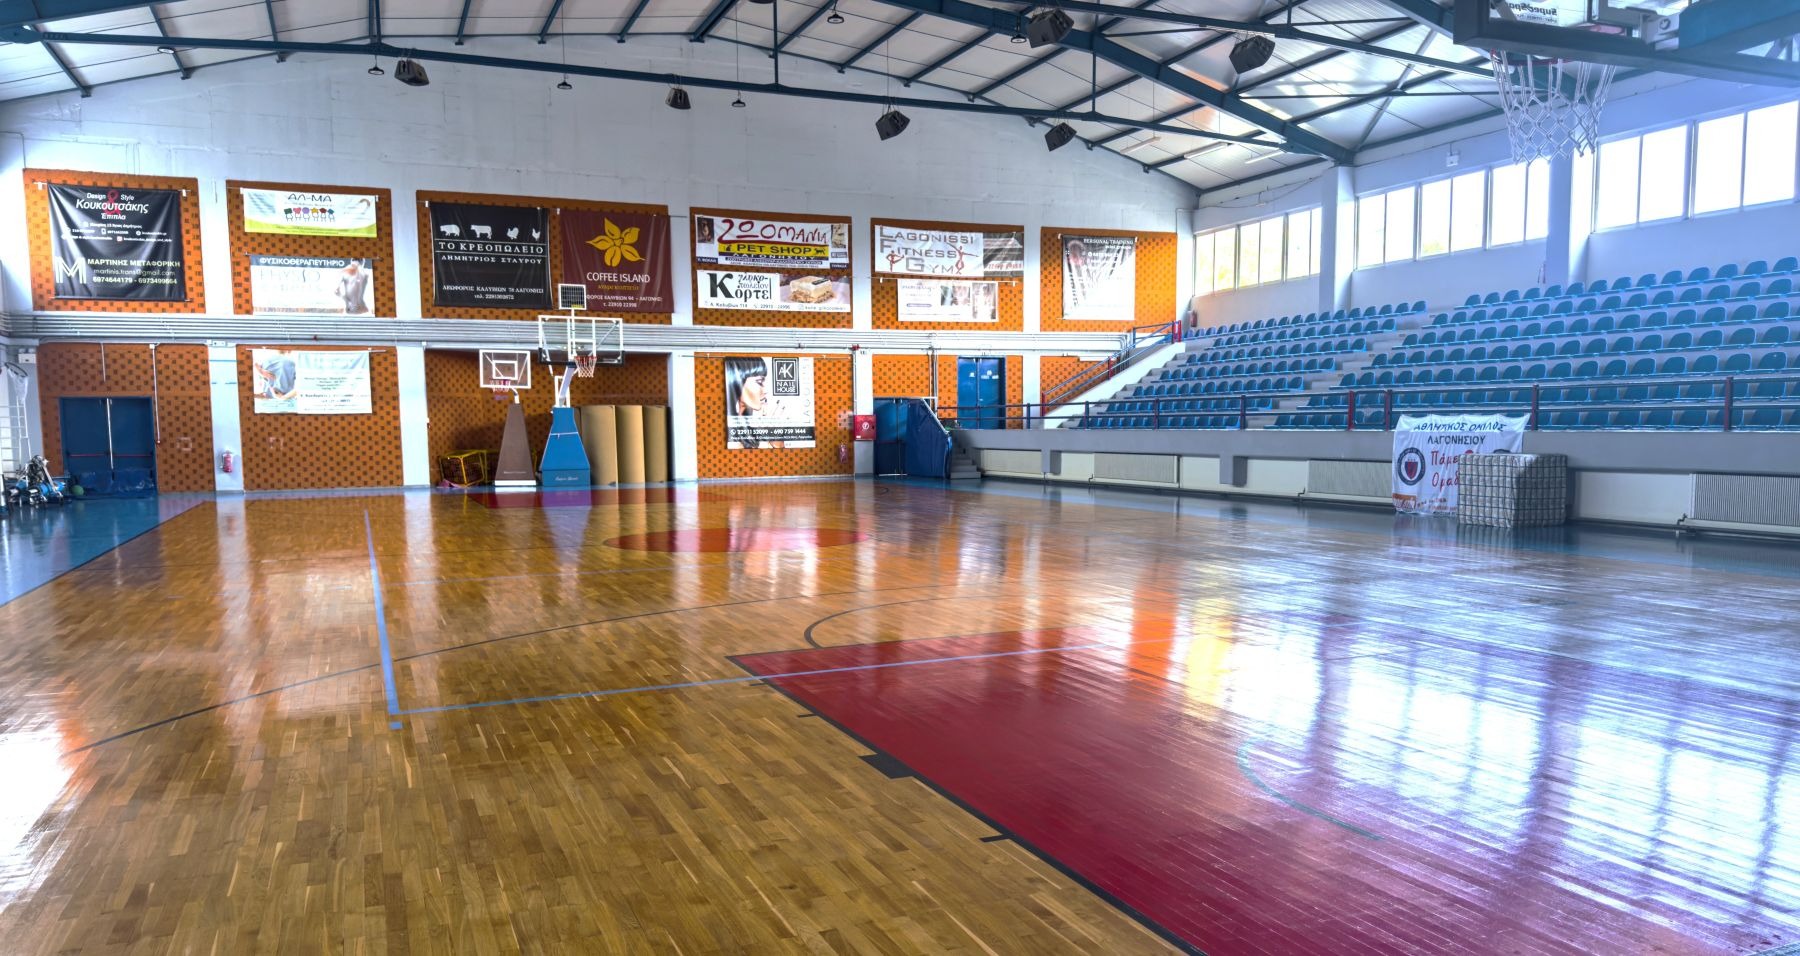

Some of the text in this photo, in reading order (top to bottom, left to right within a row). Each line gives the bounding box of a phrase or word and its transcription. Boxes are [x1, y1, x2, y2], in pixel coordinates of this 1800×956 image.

[76, 199, 149, 213] Κουκουτσάκης
[880, 226, 974, 244] LAGONISSI
[439, 242, 543, 253] ΤΟ ΚΡΕΟΠΩΛΕΙΟ
[737, 243, 812, 255] PET SHOP
[880, 238, 957, 258] FITNESS
[88, 258, 181, 268] ΜΑΡΤΙΝΗΣ ΜΕΤΑΦΟΡΙΚΗ
[259, 257, 345, 267] ΦΥΣΙΚΟΘΕΡΑΠΕΥΤΗΡΙΟ
[441, 255, 496, 263] ΔΗΜΗΤΡΙΟΣ
[906, 257, 954, 274] GYM
[93, 268, 175, 276] martinis.trans@gmail.com
[587, 272, 650, 283] COFFEE ISLAND
[1469, 421, 1507, 432] ΟΜΙΛΟΣ
[1428, 435, 1486, 445] ΛΑΓΟΝΗΣΙΟΥ
[1431, 449, 1459, 470] Πάμε
[1432, 471, 1459, 492] Ομαδ
